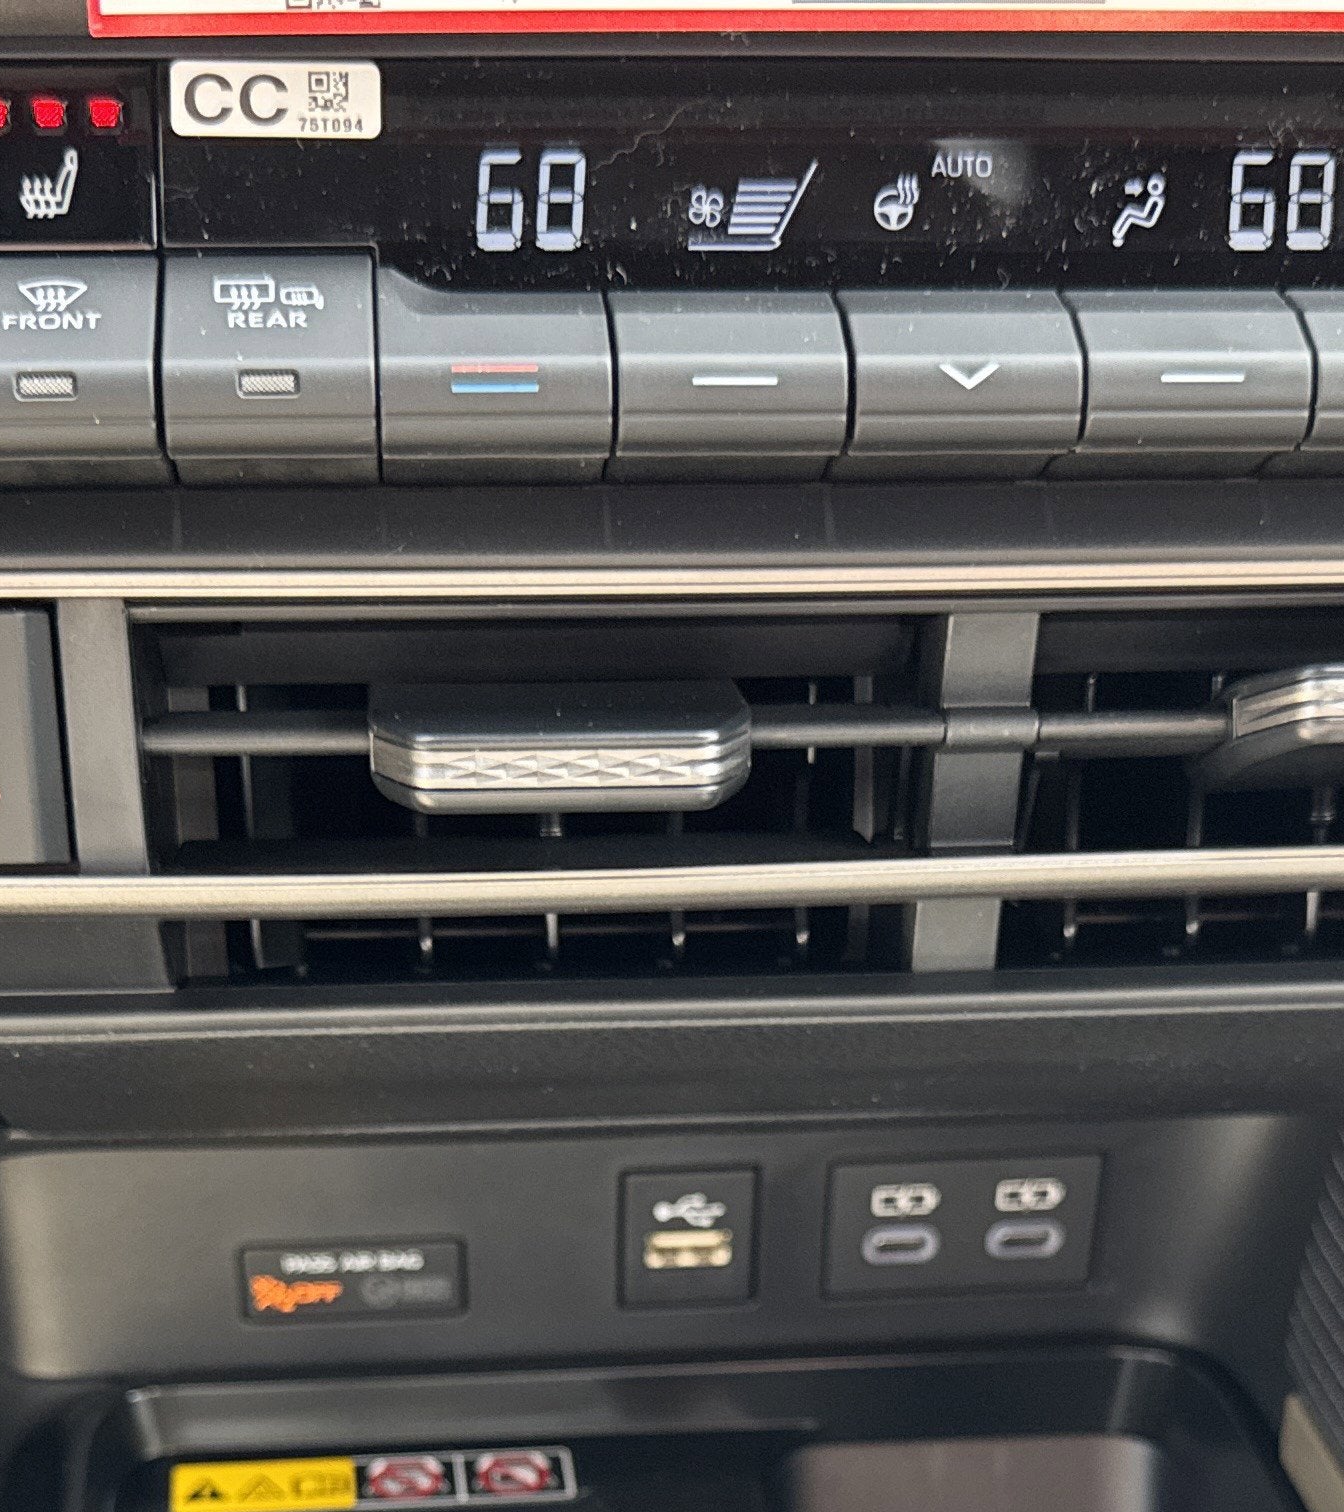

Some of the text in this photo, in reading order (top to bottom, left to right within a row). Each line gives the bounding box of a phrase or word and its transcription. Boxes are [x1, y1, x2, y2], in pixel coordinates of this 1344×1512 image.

[184, 73, 288, 126] CC
[931, 153, 993, 179] AUTO
[476, 150, 587, 252] 68
[1227, 150, 1338, 252] 68
[1, 311, 102, 331] FRONT
[227, 310, 308, 329] REAR
